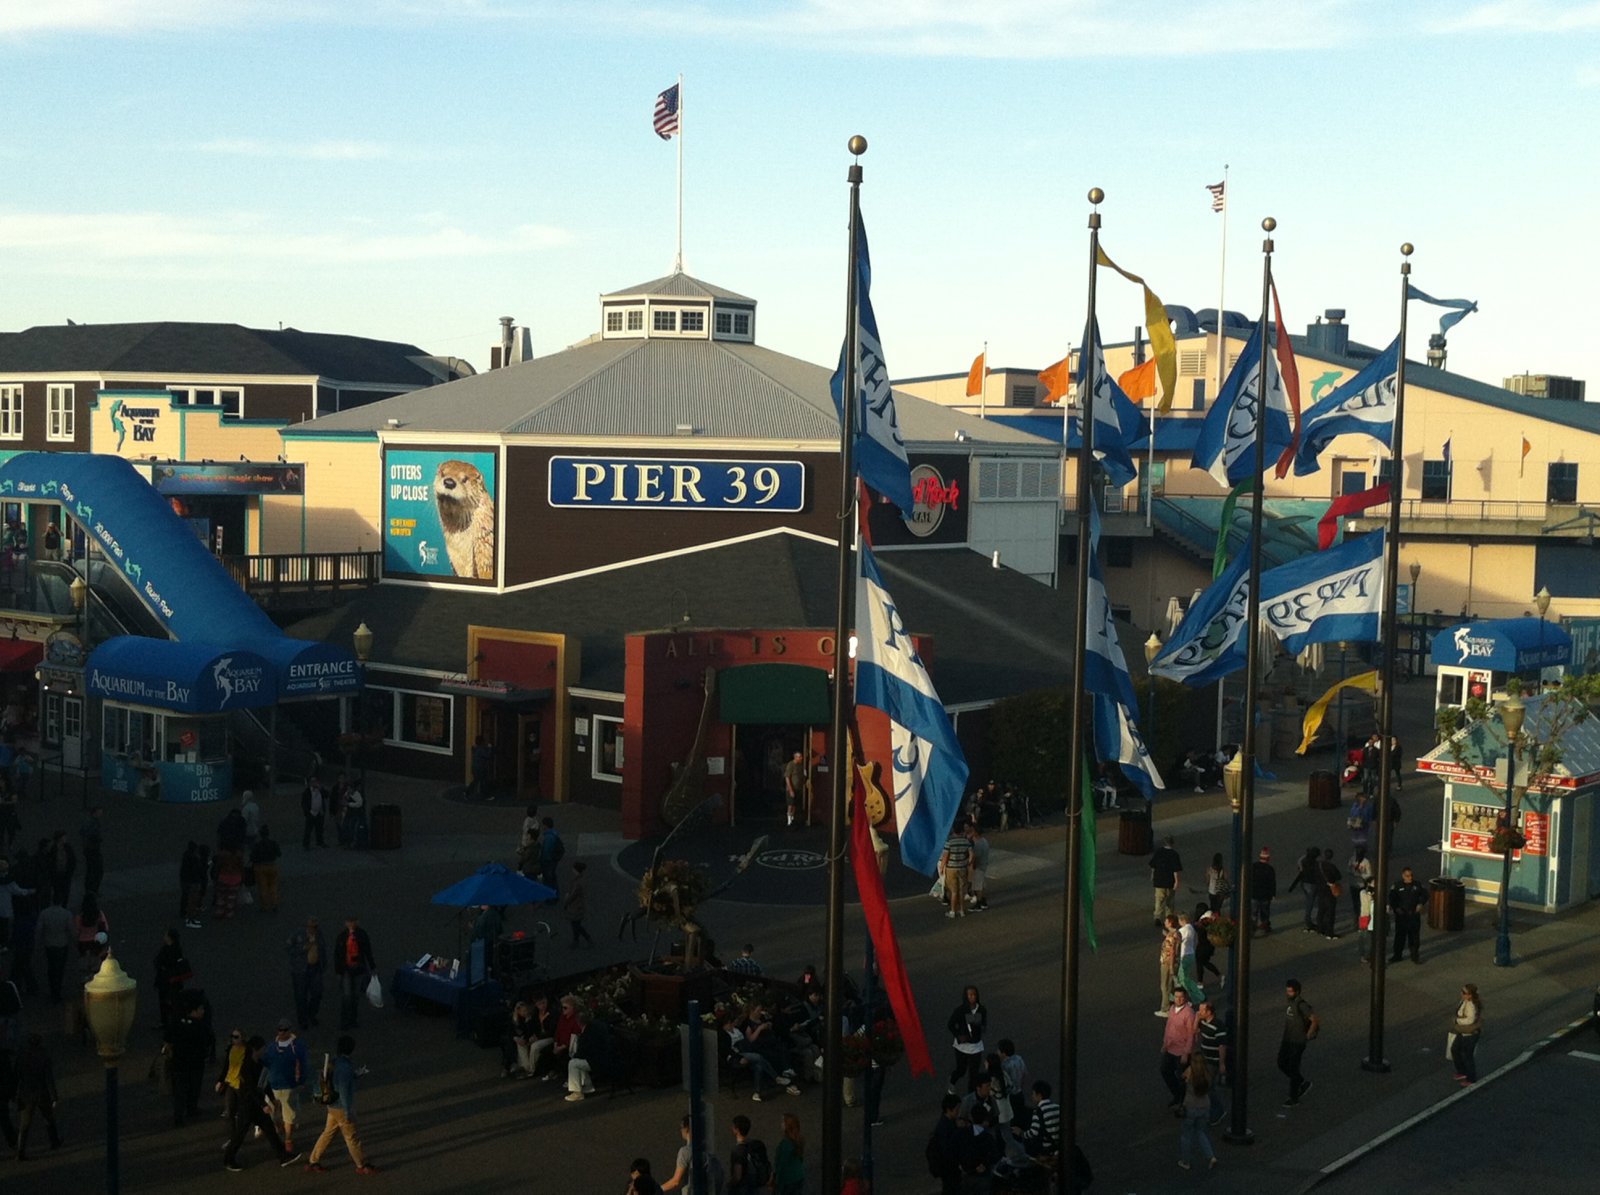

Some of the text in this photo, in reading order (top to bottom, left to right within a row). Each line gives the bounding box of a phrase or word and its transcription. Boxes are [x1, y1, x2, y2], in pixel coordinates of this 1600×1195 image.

[133, 425, 156, 442] BAY
[390, 464, 422, 481] OTTERS
[572, 463, 781, 504] PIER 39
[390, 484, 429, 501] UP CLOSE
[665, 636, 785, 657] ALL IS
[1470, 644, 1494, 657] BAY
[290, 660, 353, 678] ENTRANCE
[91, 668, 145, 697] AQUARIUM
[166, 681, 190, 703] BAY
[234, 678, 261, 693] BAY
[200, 776, 212, 789] UP
[191, 788, 220, 802] CLOSE
